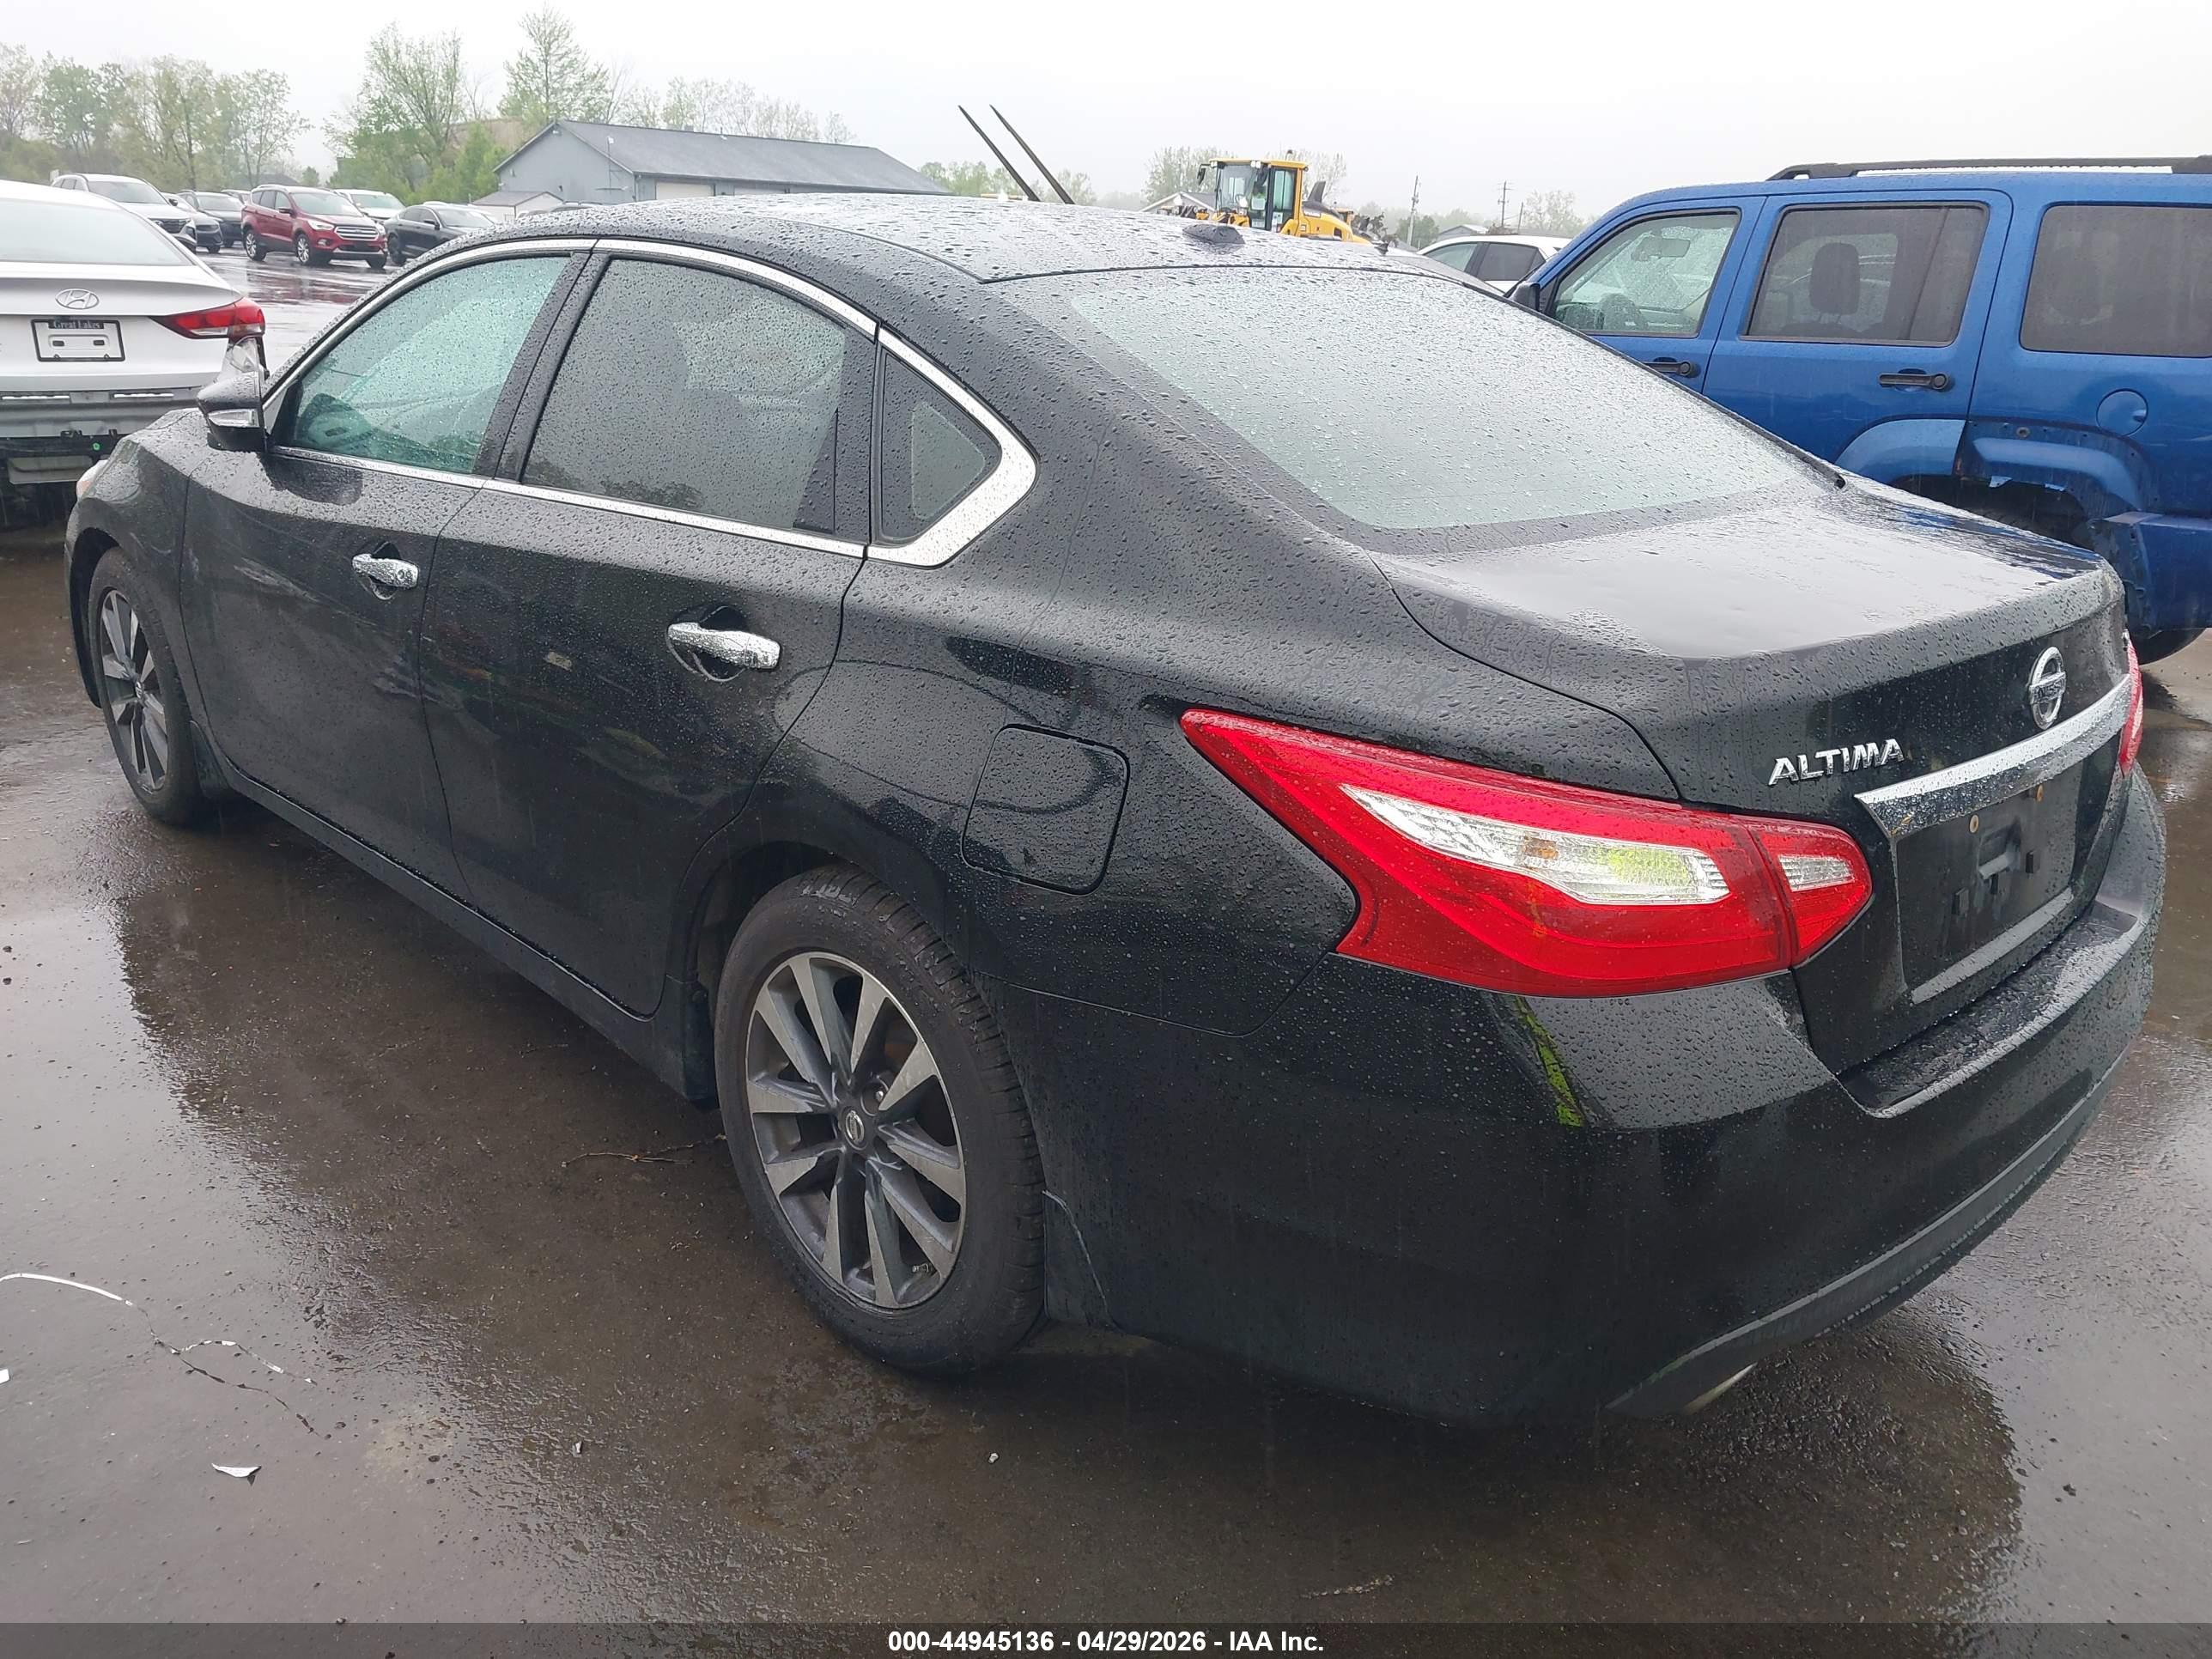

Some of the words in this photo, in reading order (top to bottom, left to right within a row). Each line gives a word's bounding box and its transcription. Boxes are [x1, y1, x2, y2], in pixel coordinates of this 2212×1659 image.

[54, 320, 76, 329] Great
[78, 320, 100, 329] Lakes
[1768, 738, 1905, 786] ALTIMA
